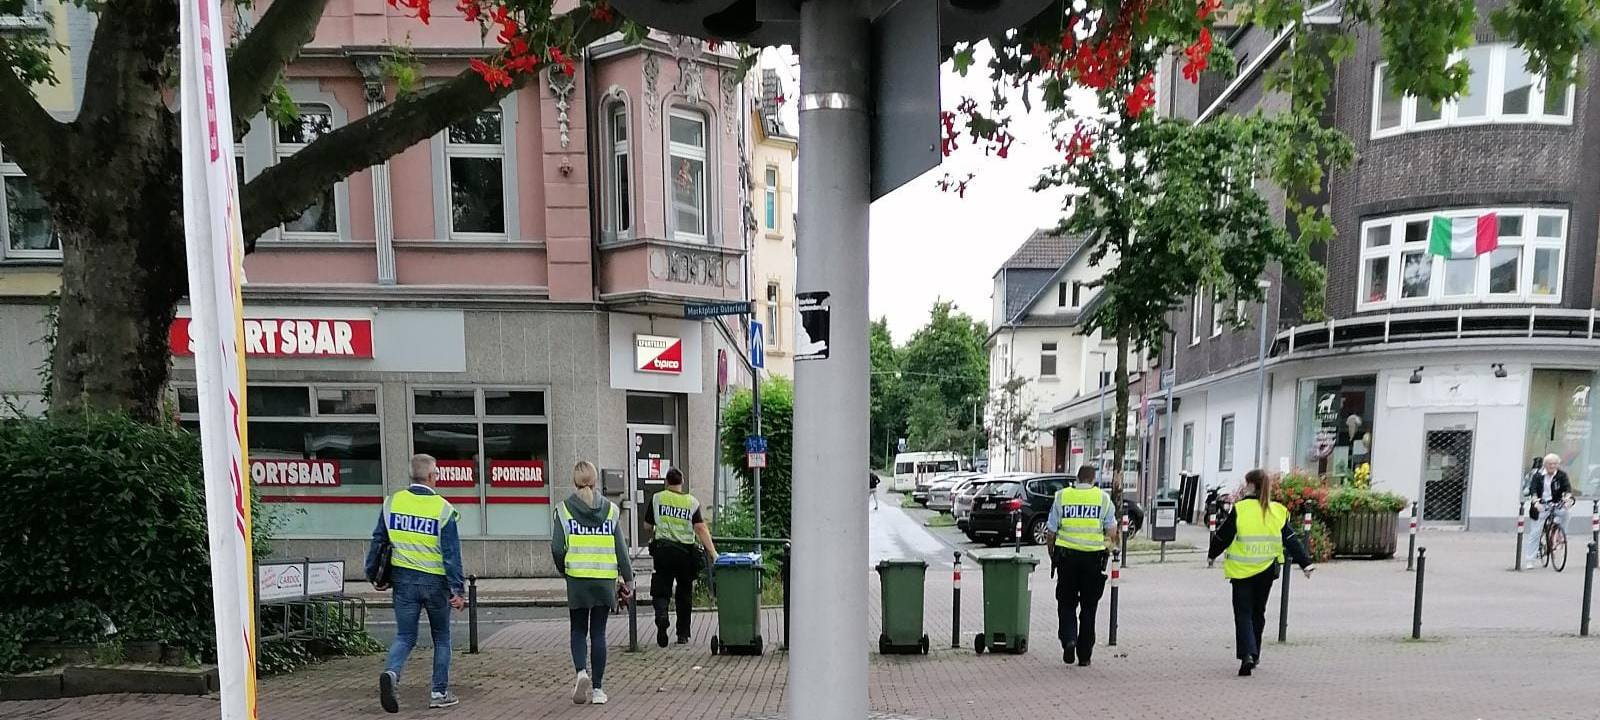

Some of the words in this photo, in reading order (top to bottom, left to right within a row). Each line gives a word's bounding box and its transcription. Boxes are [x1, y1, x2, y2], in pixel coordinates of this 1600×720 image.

[687, 305, 719, 317] Marktplatz
[720, 302, 747, 313] Osterfeld
[187, 320, 354, 355] RTSBAR
[251, 461, 336, 484] ORTSBAR
[434, 466, 473, 481] ORTSBAR
[492, 466, 542, 481] SPORTSBAR
[661, 505, 689, 519] POLIZEI
[1064, 504, 1099, 518] POLIZEI
[394, 513, 435, 534] POLIZEI
[571, 519, 612, 535] POLIZEI
